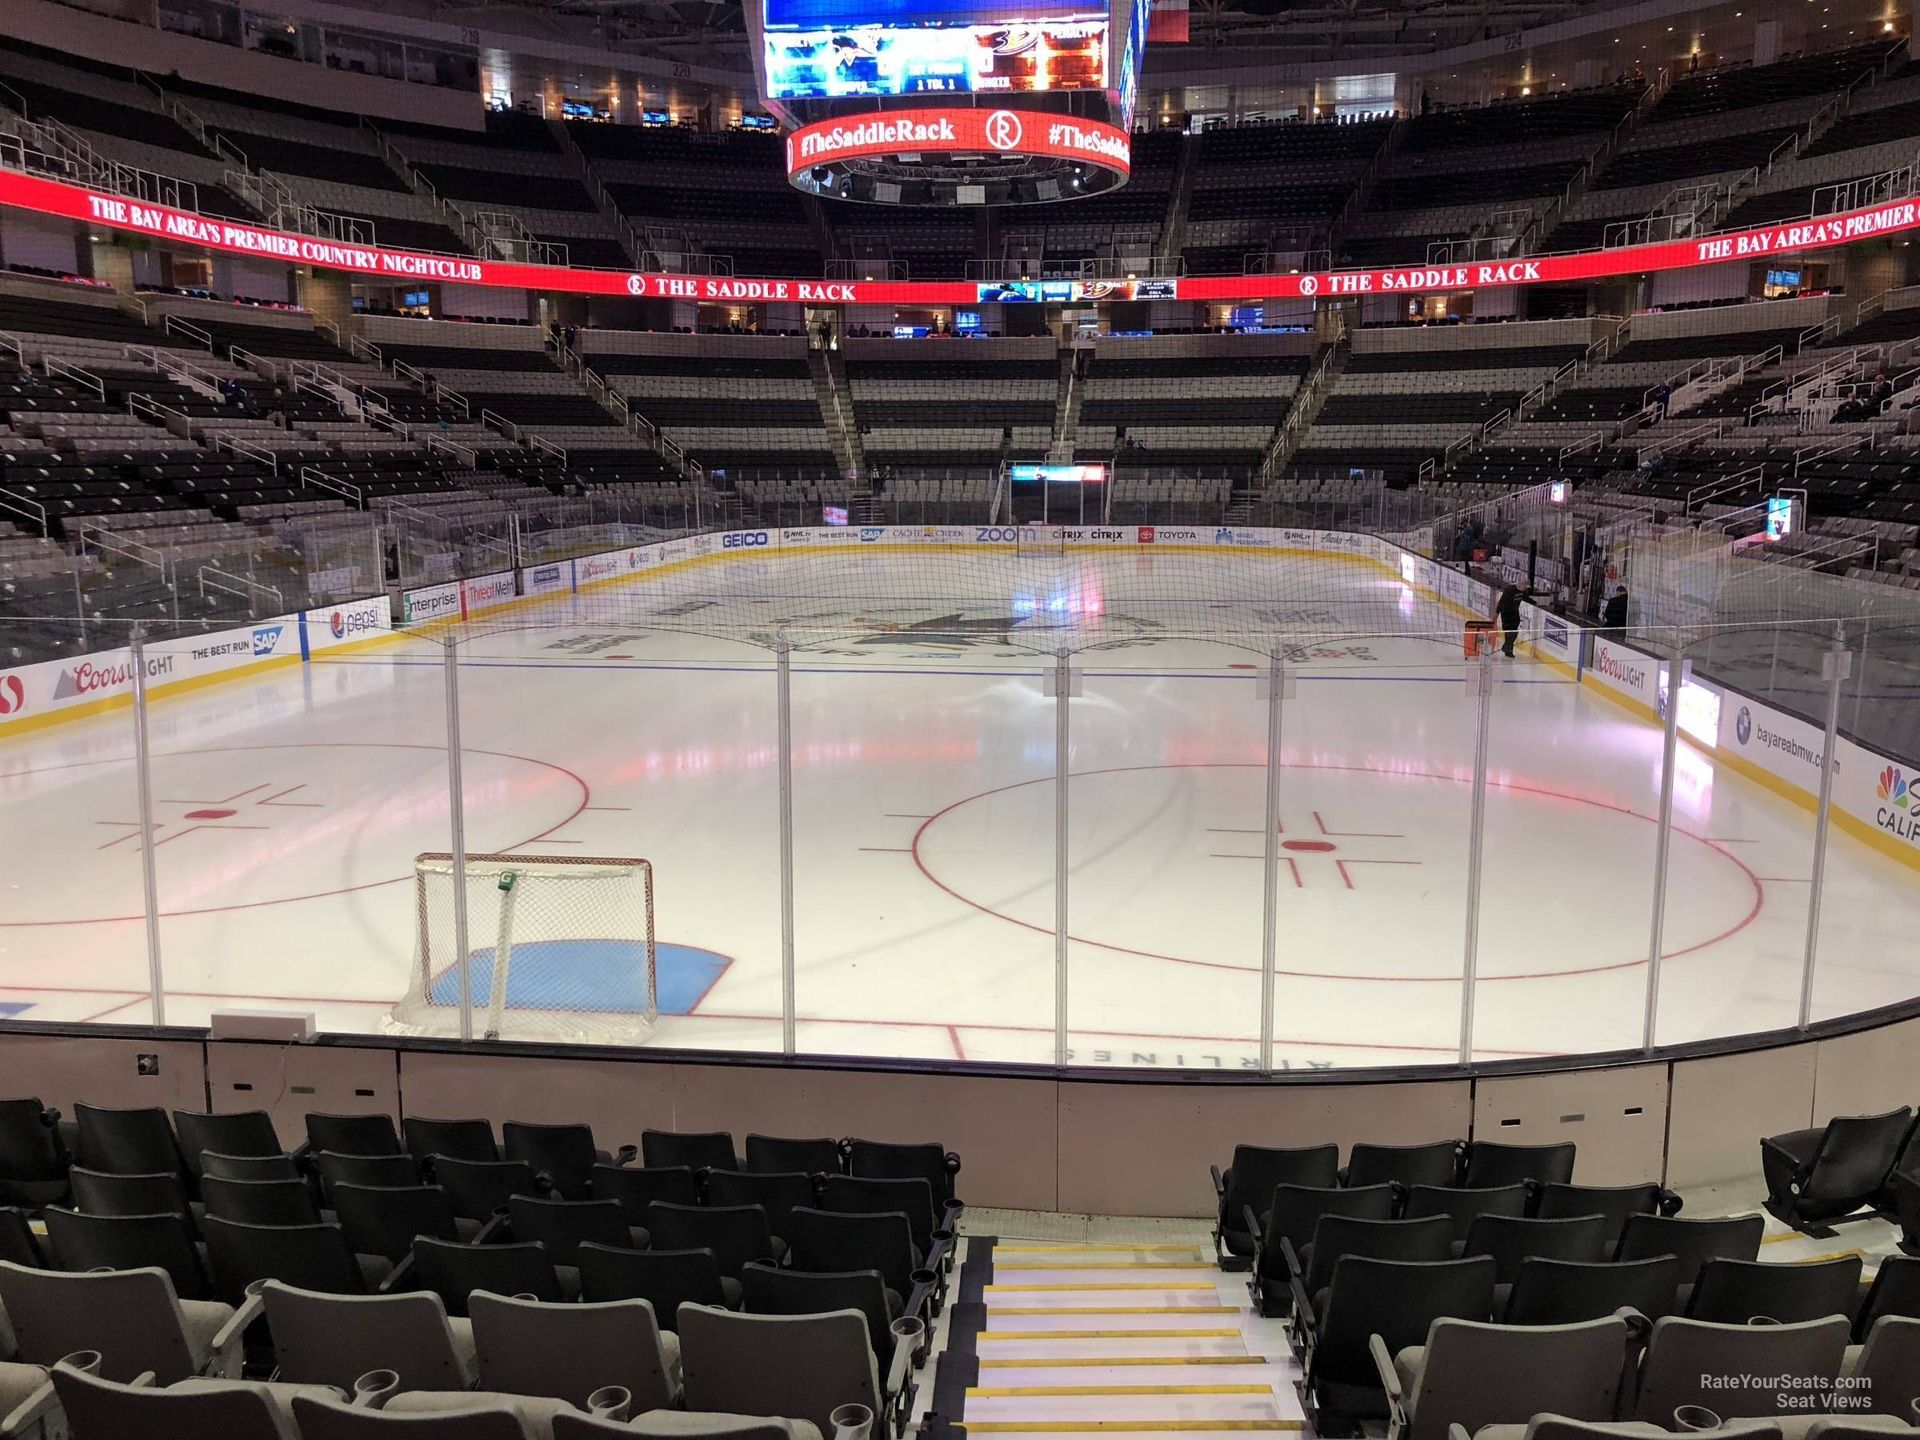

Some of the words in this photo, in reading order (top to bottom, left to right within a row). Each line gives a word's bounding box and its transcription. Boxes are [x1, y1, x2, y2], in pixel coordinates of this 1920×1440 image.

[88, 195, 128, 223] THE
[131, 204, 163, 231] BAY
[166, 215, 221, 244] AREA'S
[223, 226, 300, 258] PREMIER
[301, 241, 379, 269] COUNTRY
[382, 253, 482, 281] NIGHTCLUB
[1697, 239, 1732, 261] THE
[1736, 231, 1774, 255] BAY
[1774, 220, 1843, 249] AREA'S
[1845, 203, 1915, 238] PREMIER
[655, 277, 698, 297] THE
[706, 280, 789, 299] SADDLE
[798, 283, 857, 301] RACK
[1327, 274, 1373, 293] THE
[1381, 268, 1469, 290] SADDLE
[1478, 261, 1541, 284] RACK
[722, 531, 769, 549] GEICO
[1158, 531, 1196, 540] TOYOTA
[468, 578, 517, 602] ThreatMetri
[346, 605, 379, 637] pepsi
[192, 648, 209, 660] THE
[211, 643, 231, 656] BEST
[233, 640, 250, 652] RUN
[253, 631, 278, 651] SAP
[74, 662, 127, 694] Coors
[1600, 646, 1623, 681] Coors
[1622, 664, 1646, 691] LIGHT
[501, 872, 513, 883] G
